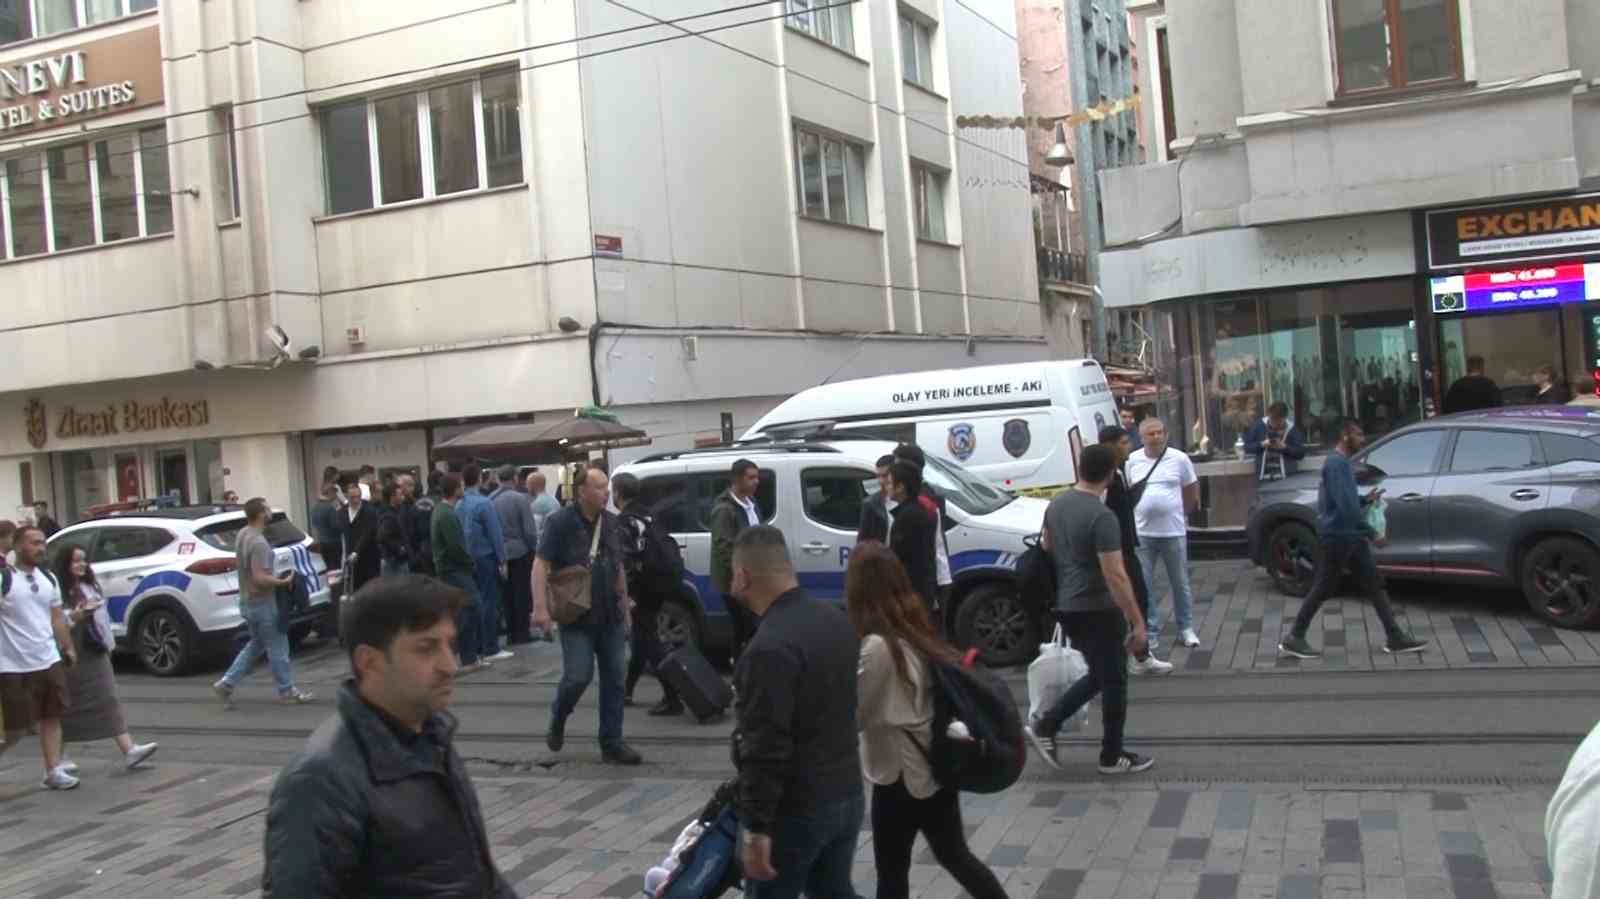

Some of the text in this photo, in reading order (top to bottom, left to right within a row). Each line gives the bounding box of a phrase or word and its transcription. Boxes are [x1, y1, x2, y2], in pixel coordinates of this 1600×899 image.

[38, 99, 56, 120] &
[59, 80, 136, 116] SUITES
[1457, 203, 1600, 239] EXCHAN
[892, 391, 920, 403] OLAY
